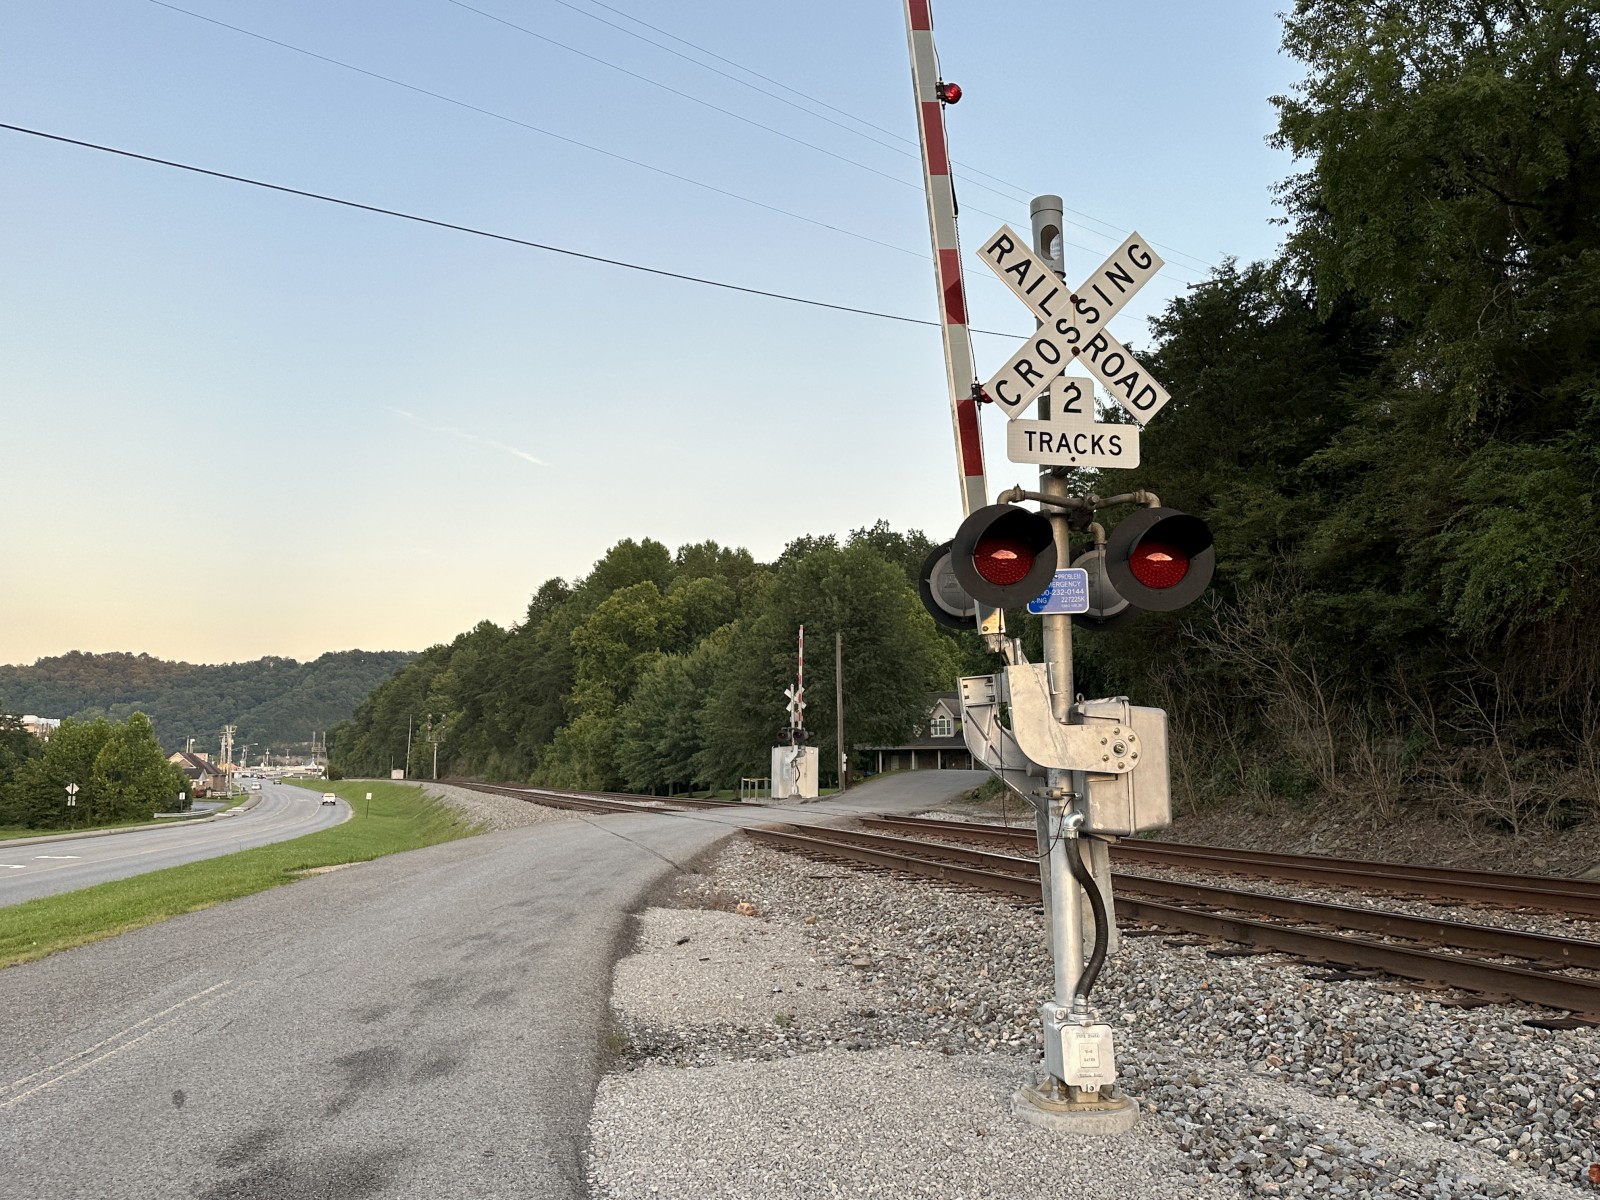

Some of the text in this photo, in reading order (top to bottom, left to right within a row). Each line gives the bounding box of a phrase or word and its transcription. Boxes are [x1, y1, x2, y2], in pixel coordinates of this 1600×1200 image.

[986, 233, 1157, 411] RAIL ROAD
[995, 243, 1152, 407] CROSSING
[1024, 430, 1122, 456] TRACKS
[1063, 384, 1082, 414] 2
